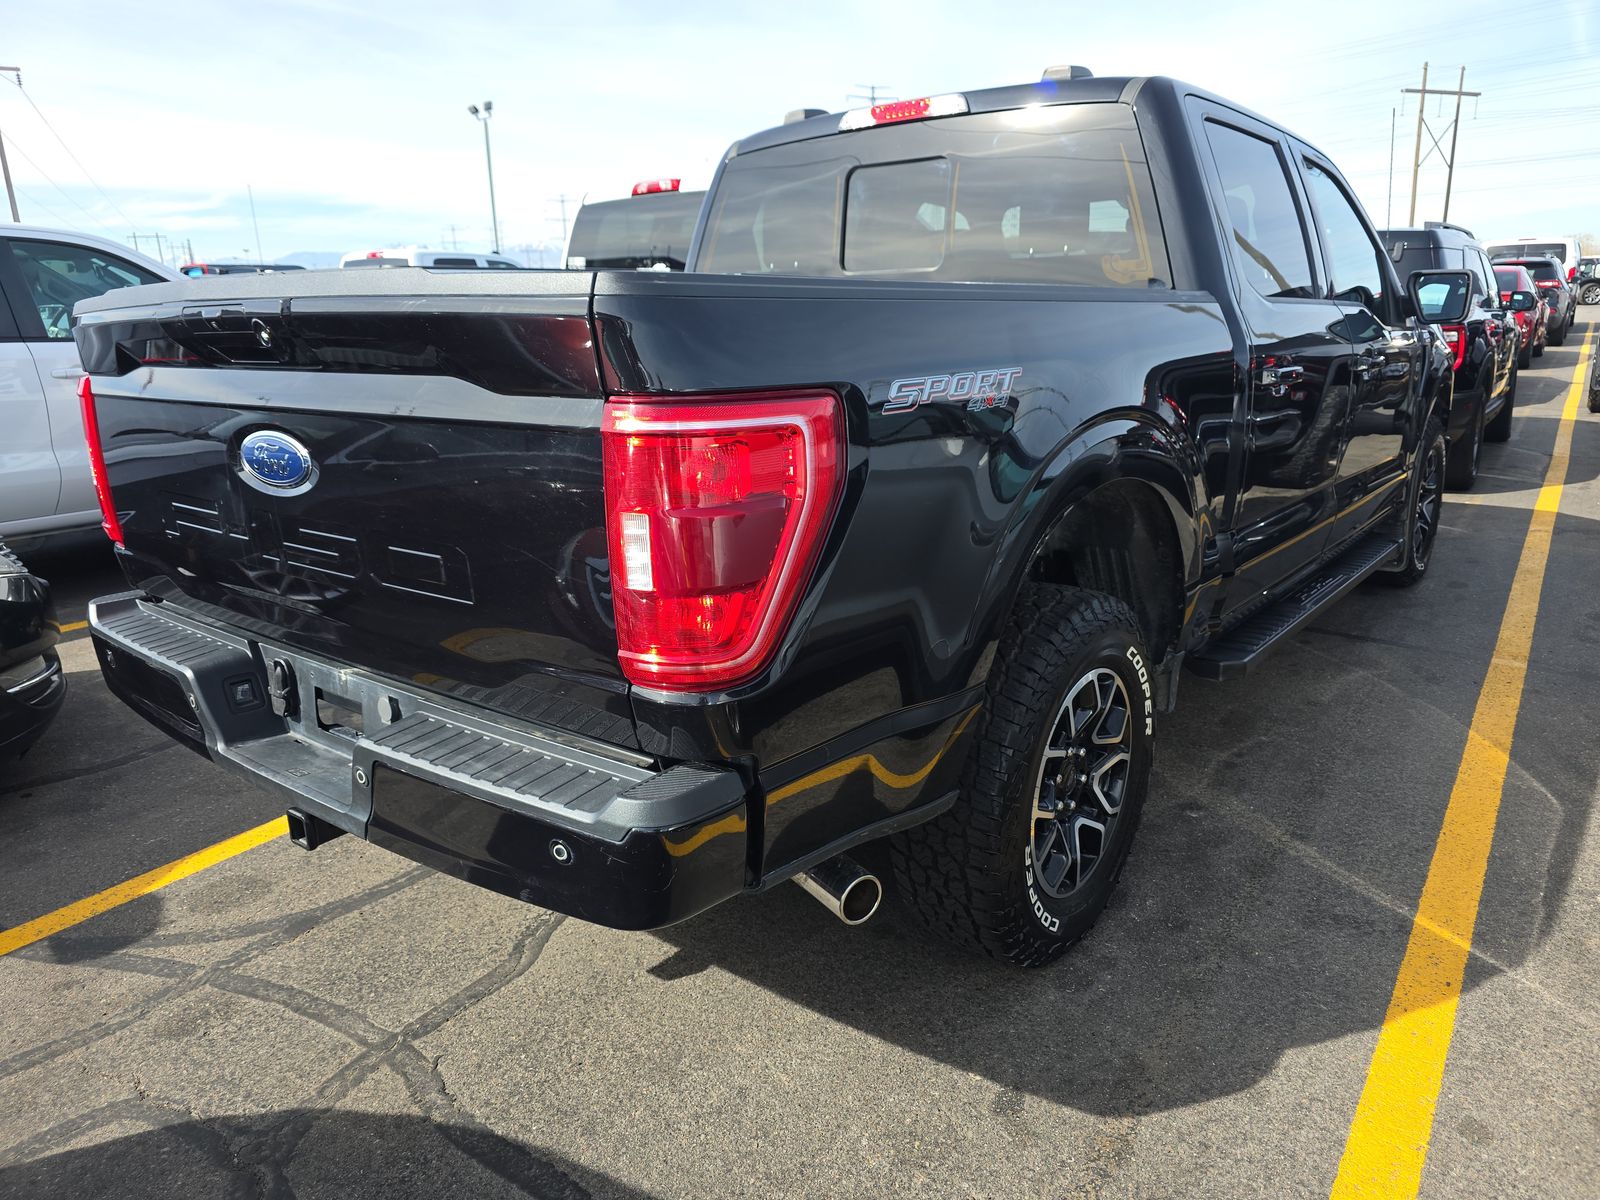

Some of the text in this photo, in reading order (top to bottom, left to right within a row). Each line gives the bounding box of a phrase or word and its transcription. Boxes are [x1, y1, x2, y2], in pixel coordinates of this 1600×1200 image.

[882, 366, 1023, 415] SPORT
[253, 442, 292, 477] Ford
[1126, 645, 1153, 736] COOPER
[1024, 844, 1060, 933] COOPER
